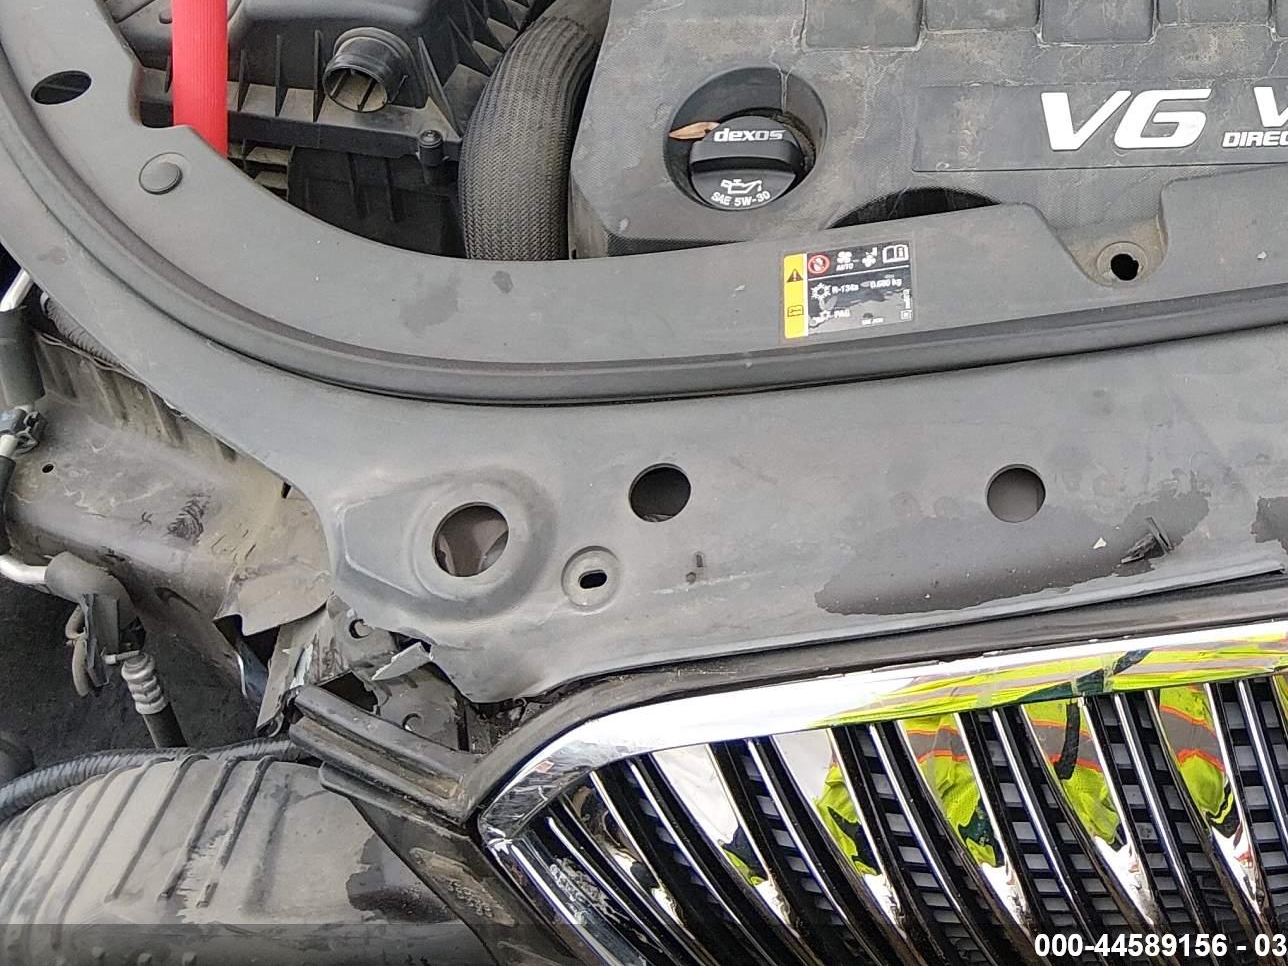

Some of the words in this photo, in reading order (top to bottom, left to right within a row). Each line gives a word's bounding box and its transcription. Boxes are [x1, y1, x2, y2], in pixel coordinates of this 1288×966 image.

[1040, 88, 1212, 151] V6
[713, 127, 787, 142] dexos
[711, 191, 732, 206] SAE
[734, 190, 771, 207] 5W-30
[836, 262, 854, 271] AUTO
[831, 283, 860, 294] R-134a
